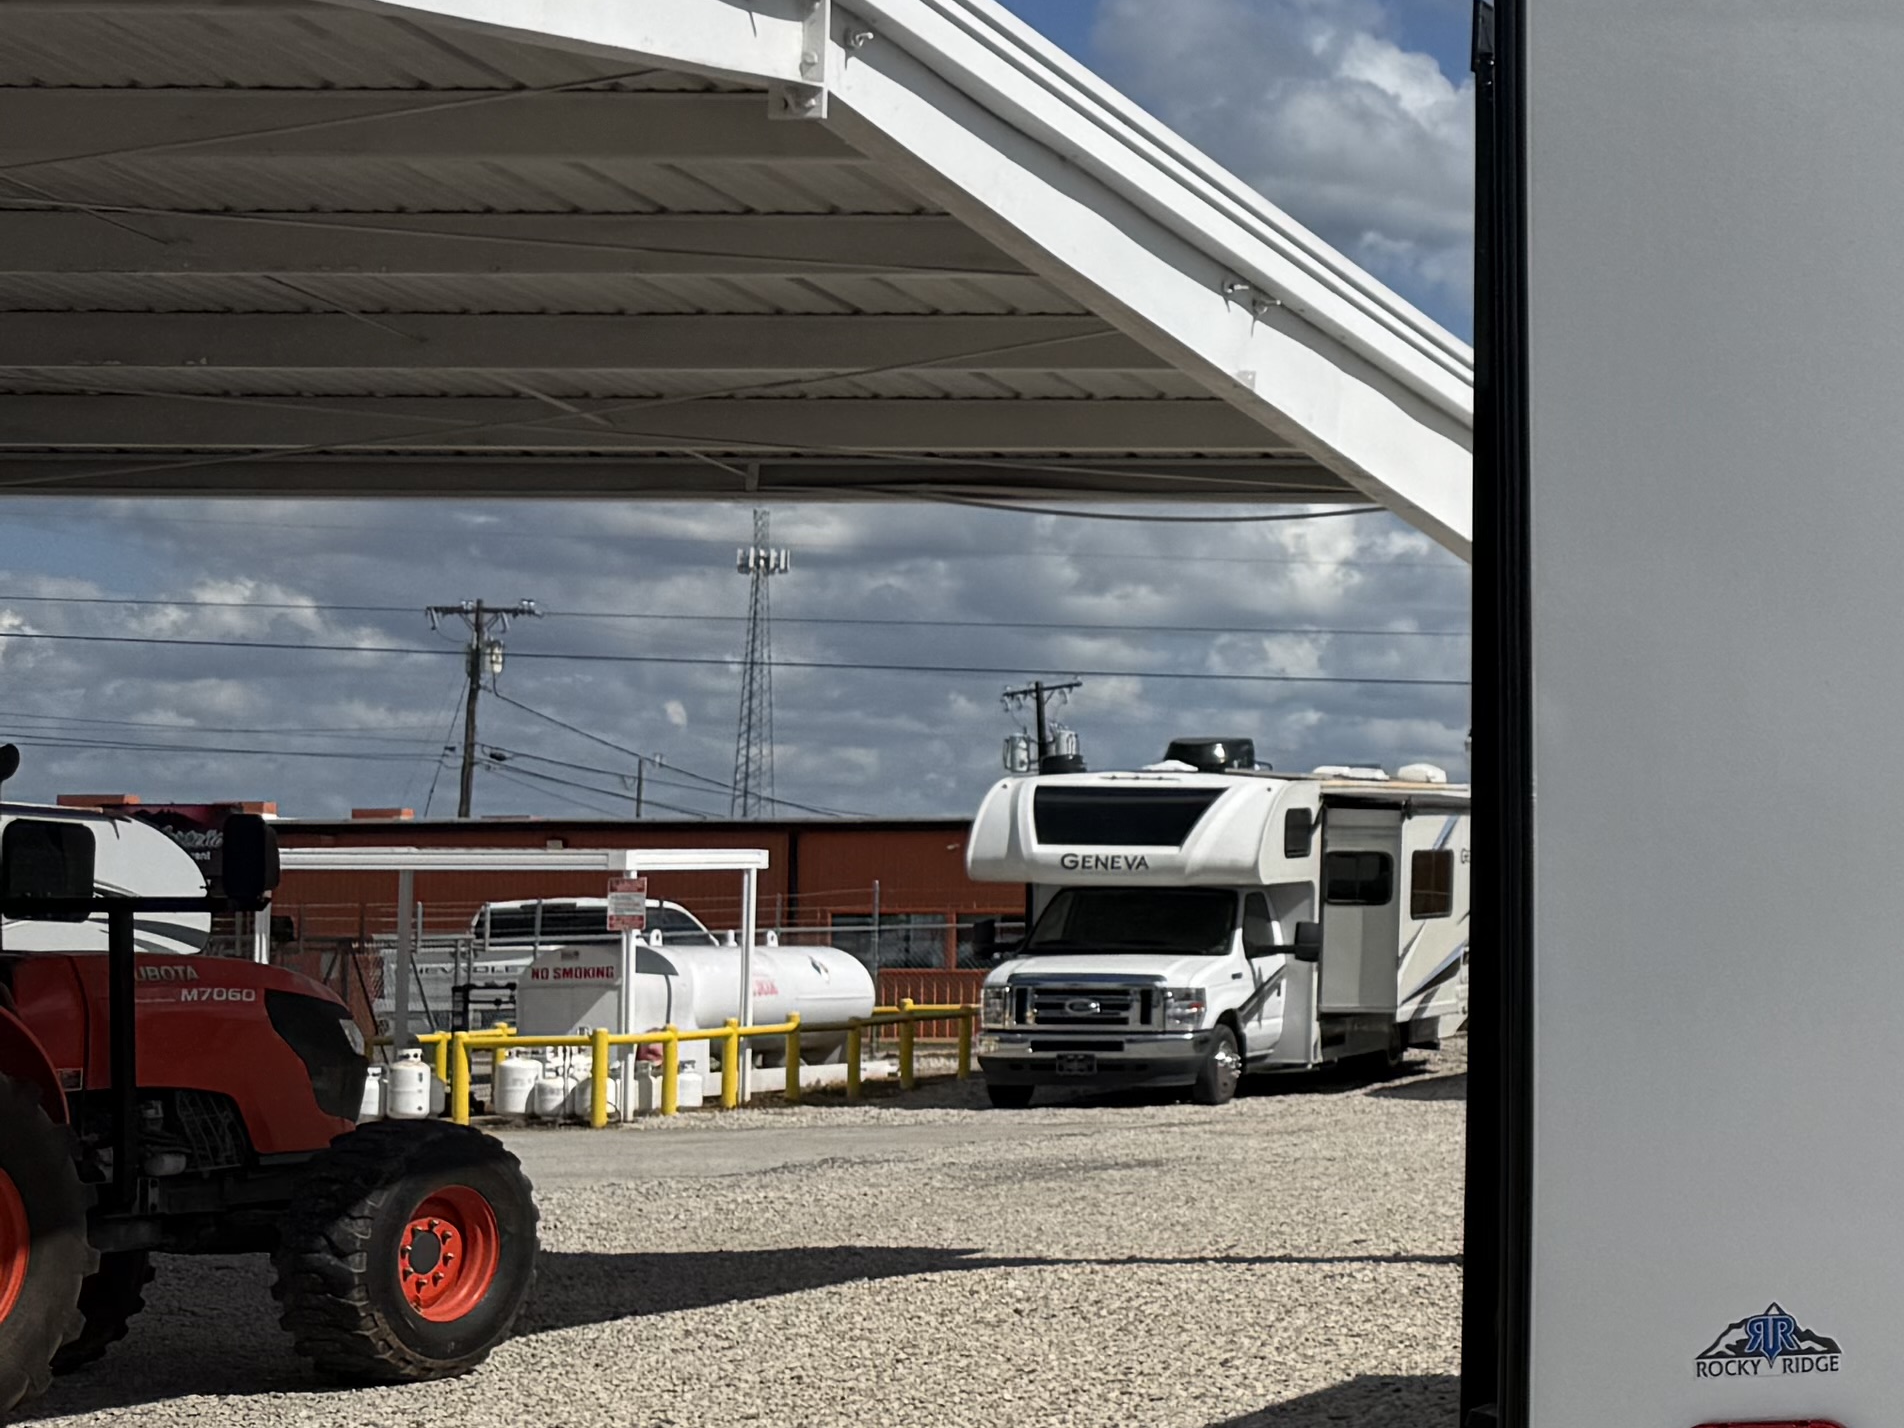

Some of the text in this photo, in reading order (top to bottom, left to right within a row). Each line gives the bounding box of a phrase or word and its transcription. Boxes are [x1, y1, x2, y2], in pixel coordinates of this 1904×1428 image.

[1060, 852, 1150, 871] GENEVA
[134, 965, 199, 981] UBOTA
[531, 966, 614, 980] NO SMOKING
[180, 987, 256, 1002] M7060
[1696, 1355, 1840, 1378] ROCKY RIDGE
